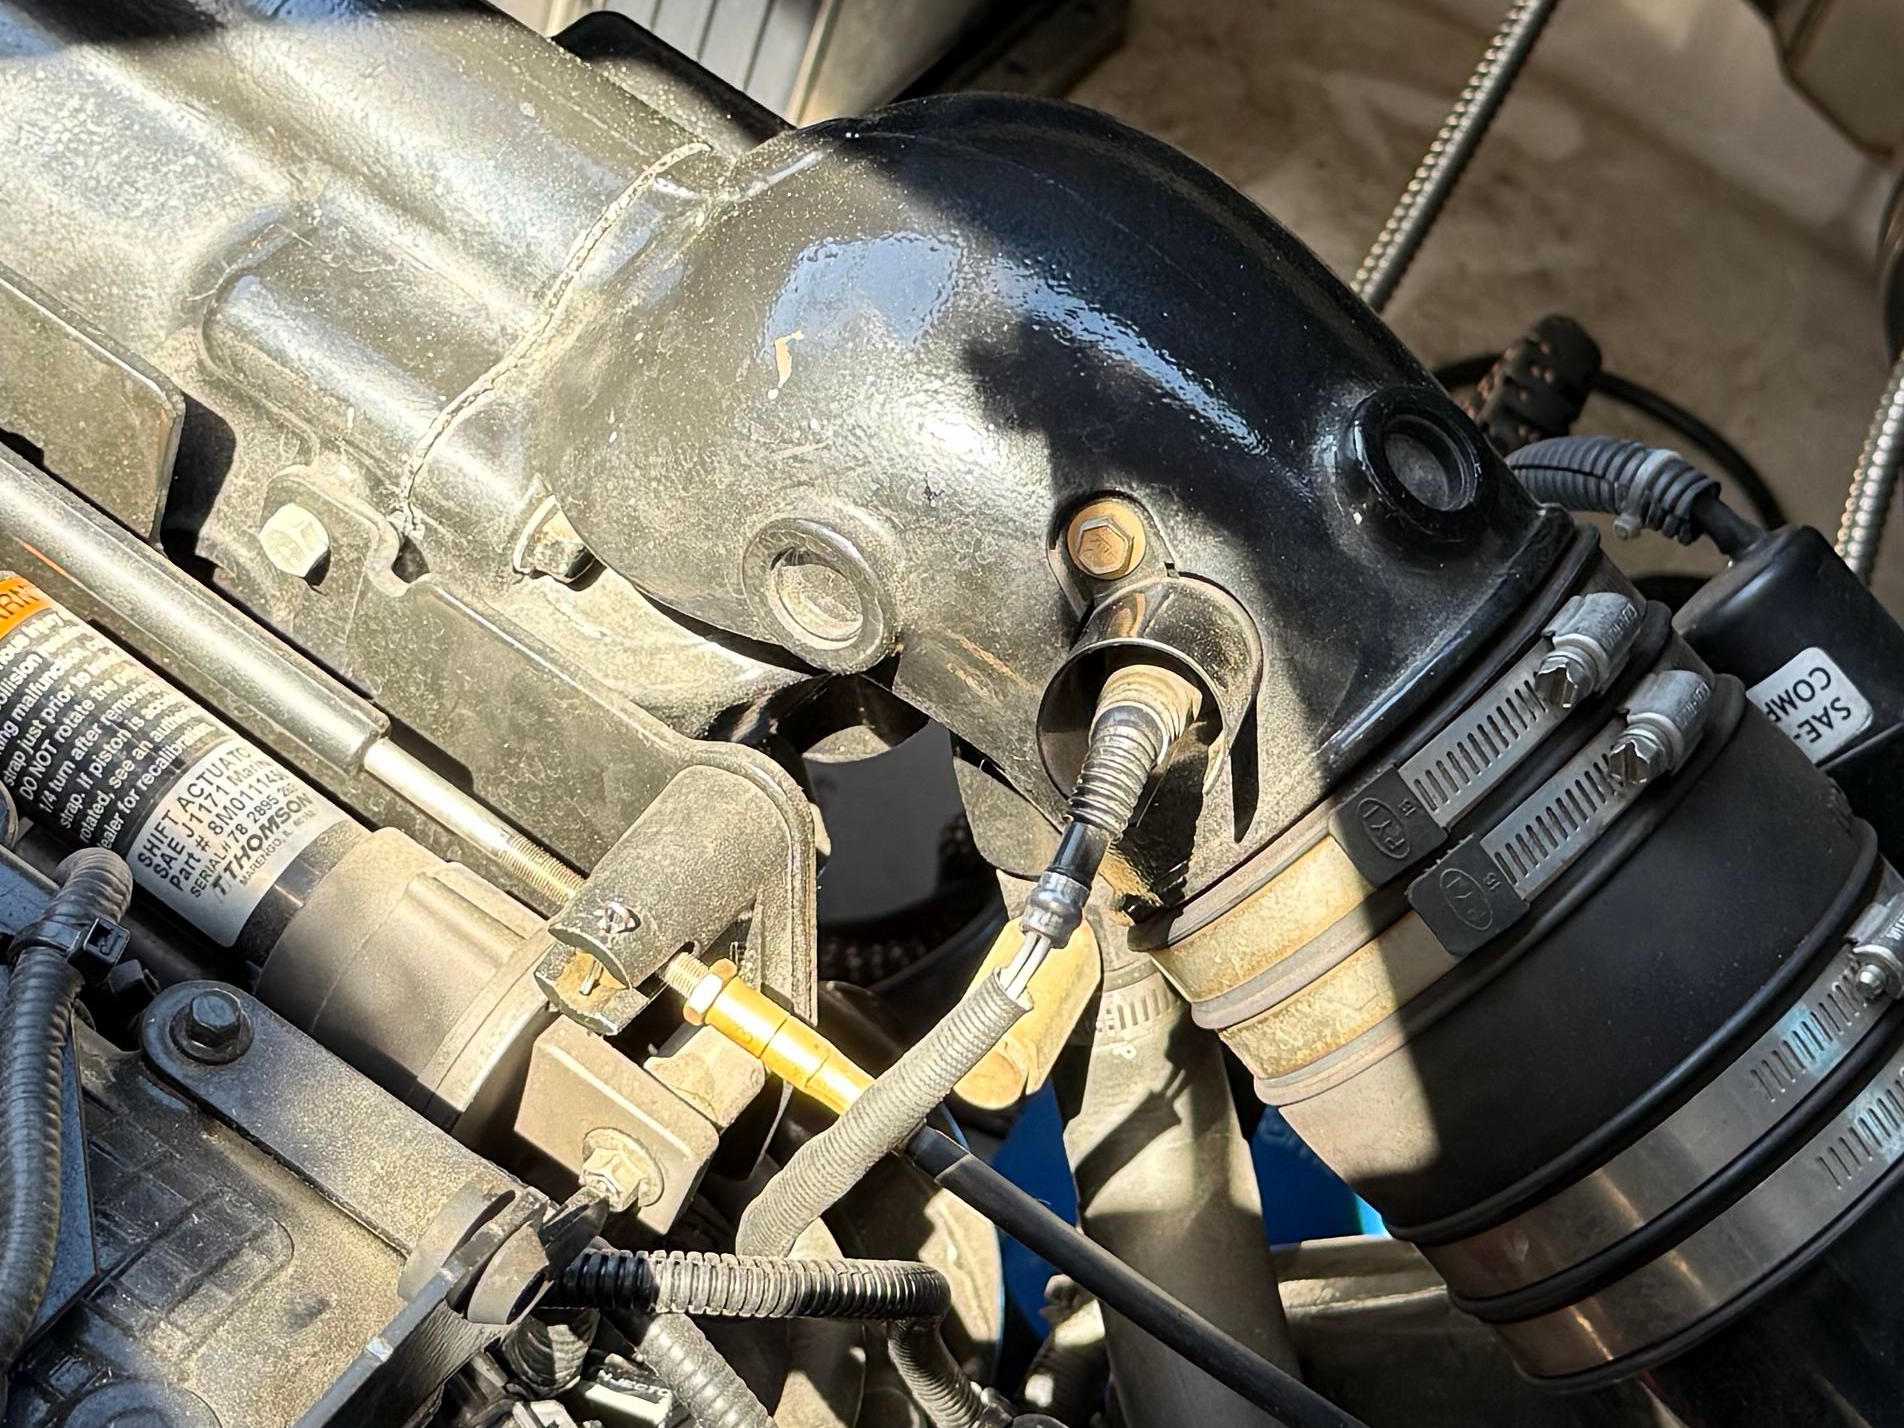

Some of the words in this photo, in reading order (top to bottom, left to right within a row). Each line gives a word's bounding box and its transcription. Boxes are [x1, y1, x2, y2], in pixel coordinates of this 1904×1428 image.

[87, 675, 119, 703] the
[0, 747, 30, 787] strap
[18, 716, 47, 754] just
[38, 679, 76, 725] prior
[67, 665, 92, 690] to
[50, 694, 96, 745] rotate
[124, 711, 146, 732] is
[28, 738, 60, 777] NOT
[47, 757, 77, 793] turn
[68, 720, 105, 762] after
[85, 726, 133, 779] piston
[107, 756, 136, 791] see
[128, 735, 155, 762] an
[18, 774, 40, 801] DO
[76, 770, 95, 790] If
[96, 811, 128, 853] ealer
[116, 786, 143, 815] for
[136, 808, 177, 869] SHIFT
[174, 746, 253, 814] ACTUATO
[151, 837, 186, 880] SAE
[178, 782, 231, 840] J1171
[245, 793, 281, 825] 2895
[169, 849, 202, 892] Part
[193, 834, 213, 854] #
[222, 790, 314, 882] THOMSON
